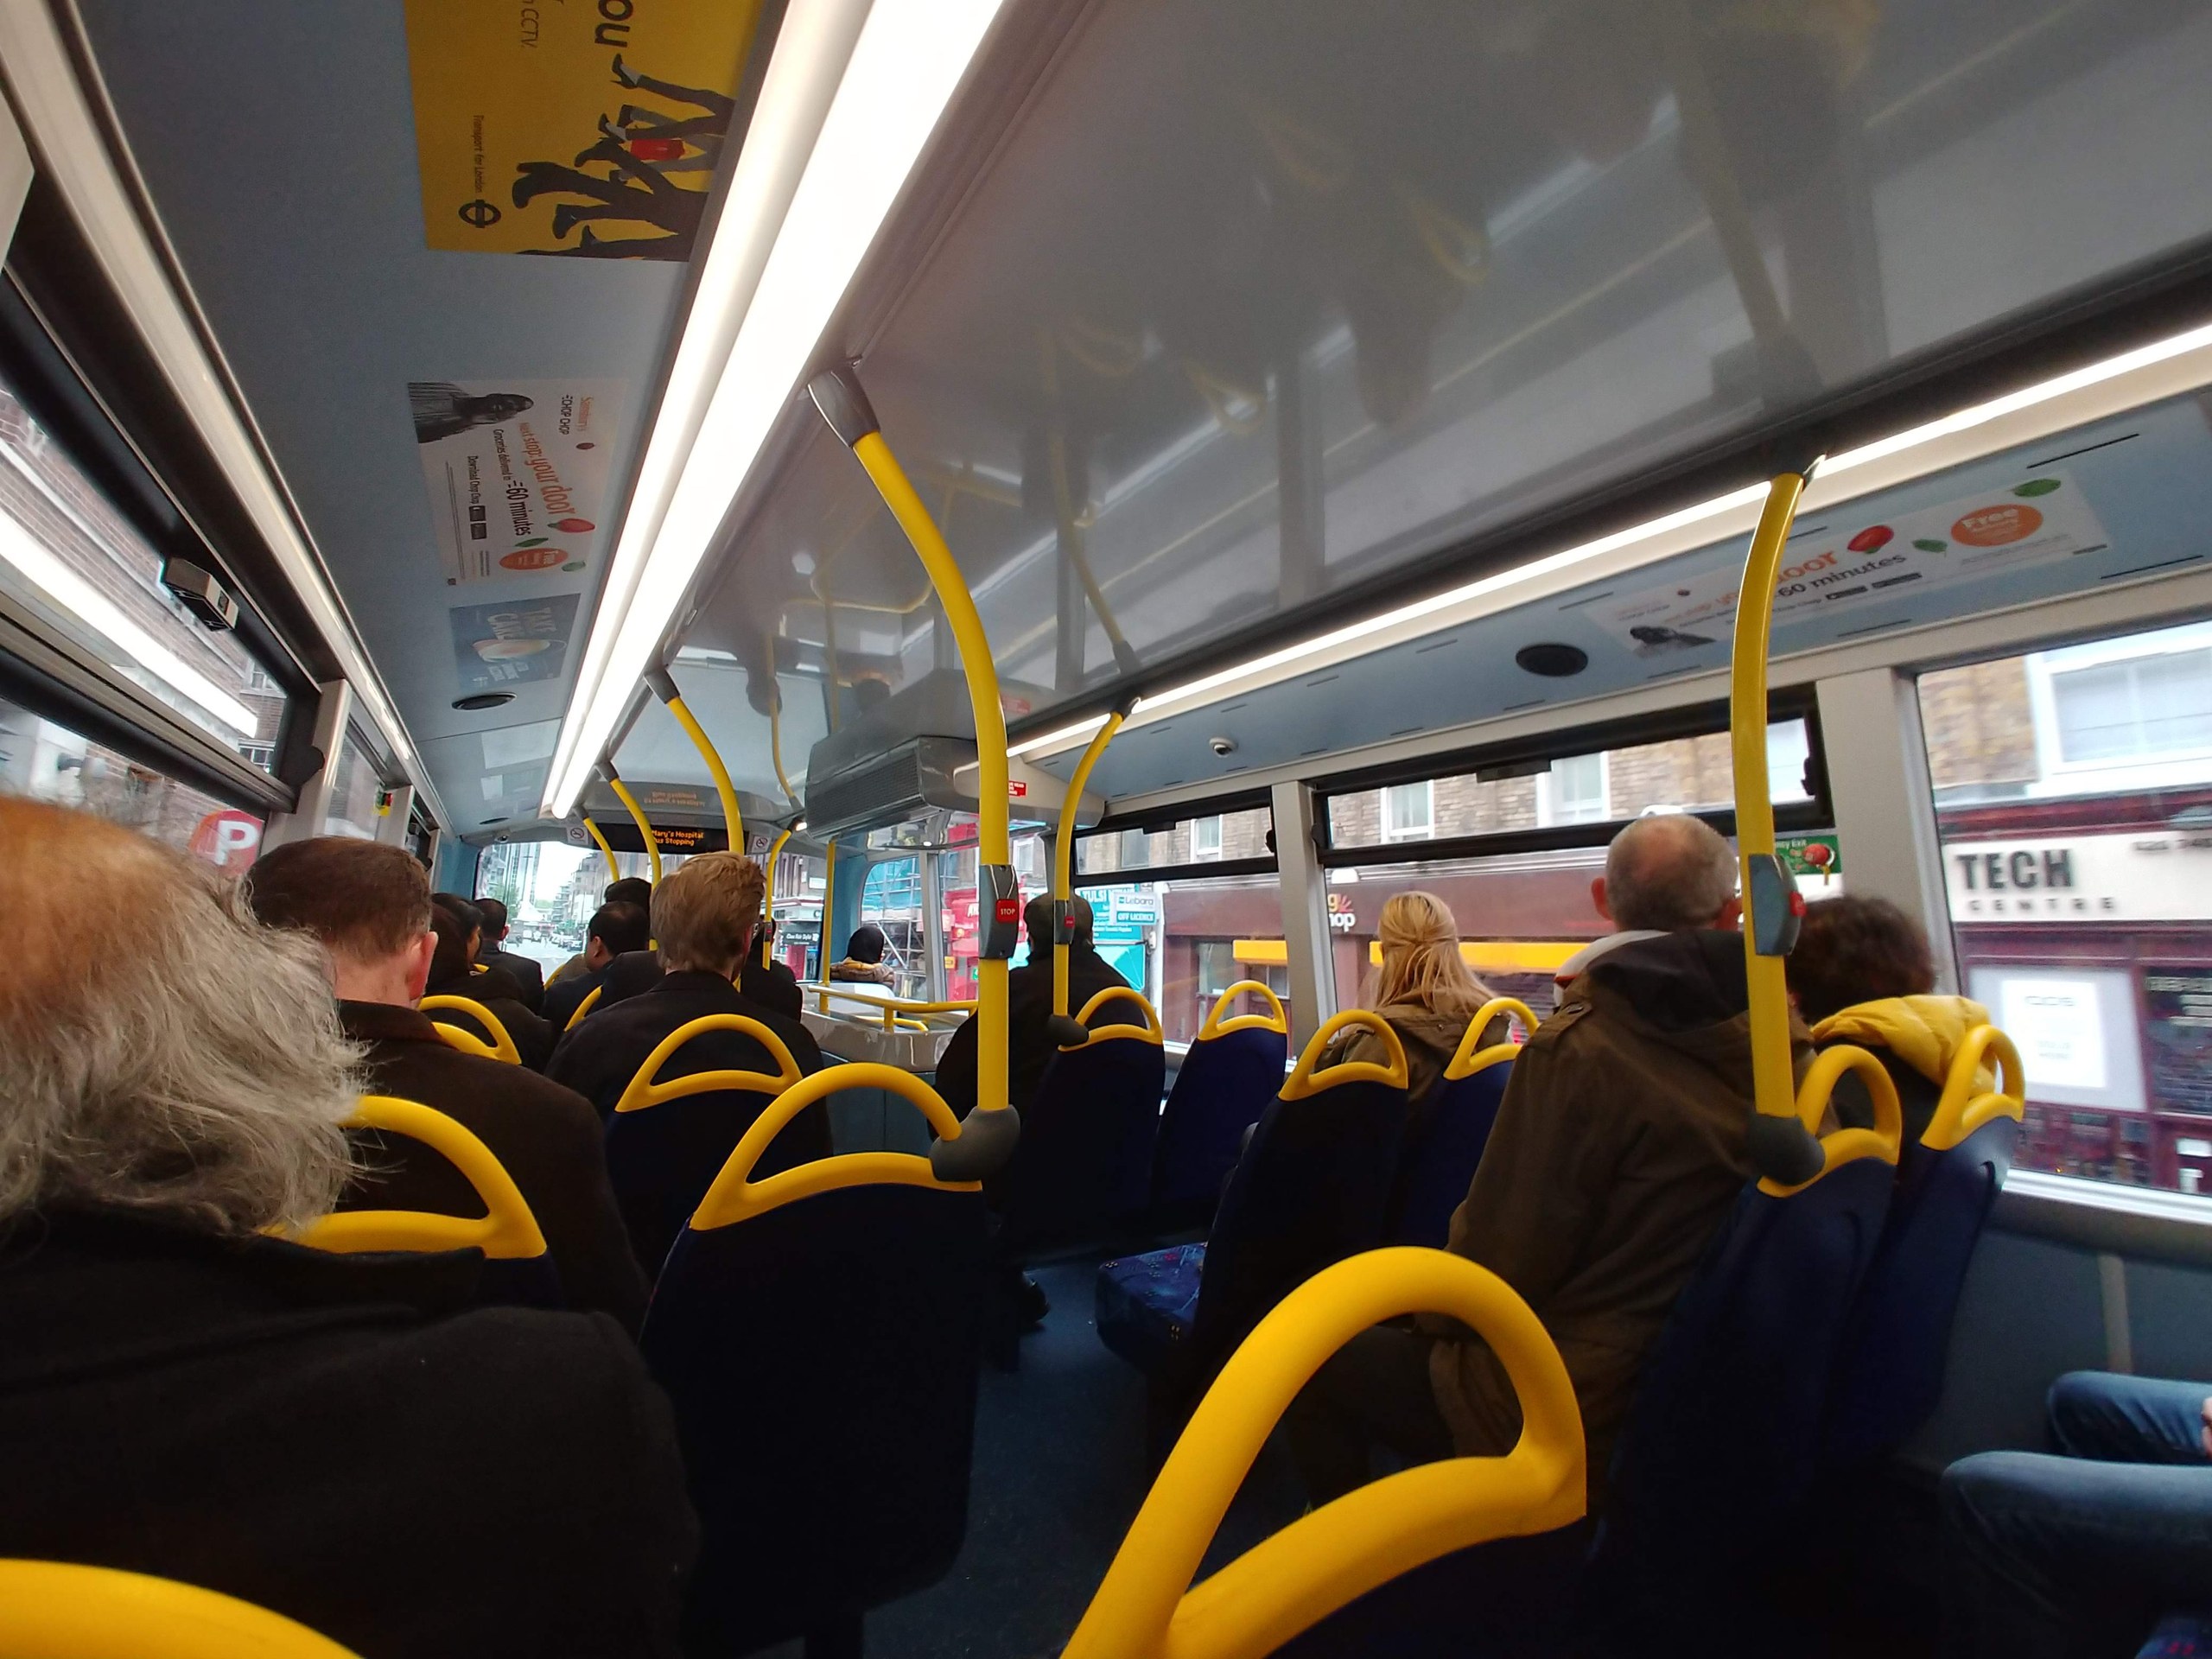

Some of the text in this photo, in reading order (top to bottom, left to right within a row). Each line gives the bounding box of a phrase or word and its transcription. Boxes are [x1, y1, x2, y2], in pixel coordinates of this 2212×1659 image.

[472, 114, 485, 194] Transport for London
[558, 417, 571, 435] CHOP
[493, 429, 510, 454] Groceries
[522, 437, 543, 458] stop:
[467, 455, 480, 481] Download
[497, 454, 512, 475] delivered
[524, 457, 559, 483] your
[542, 486, 576, 515] door
[508, 502, 533, 537] minutes
[1810, 554, 1908, 588] minutes
[215, 820, 258, 866] P
[665, 837, 695, 846] Stopping
[675, 830, 704, 839] Hospital
[1955, 849, 2073, 890] TECH
[1082, 890, 1107, 903] TULSI
[1125, 896, 1154, 906] Lebara
[1969, 897, 2114, 912] CENTRE
